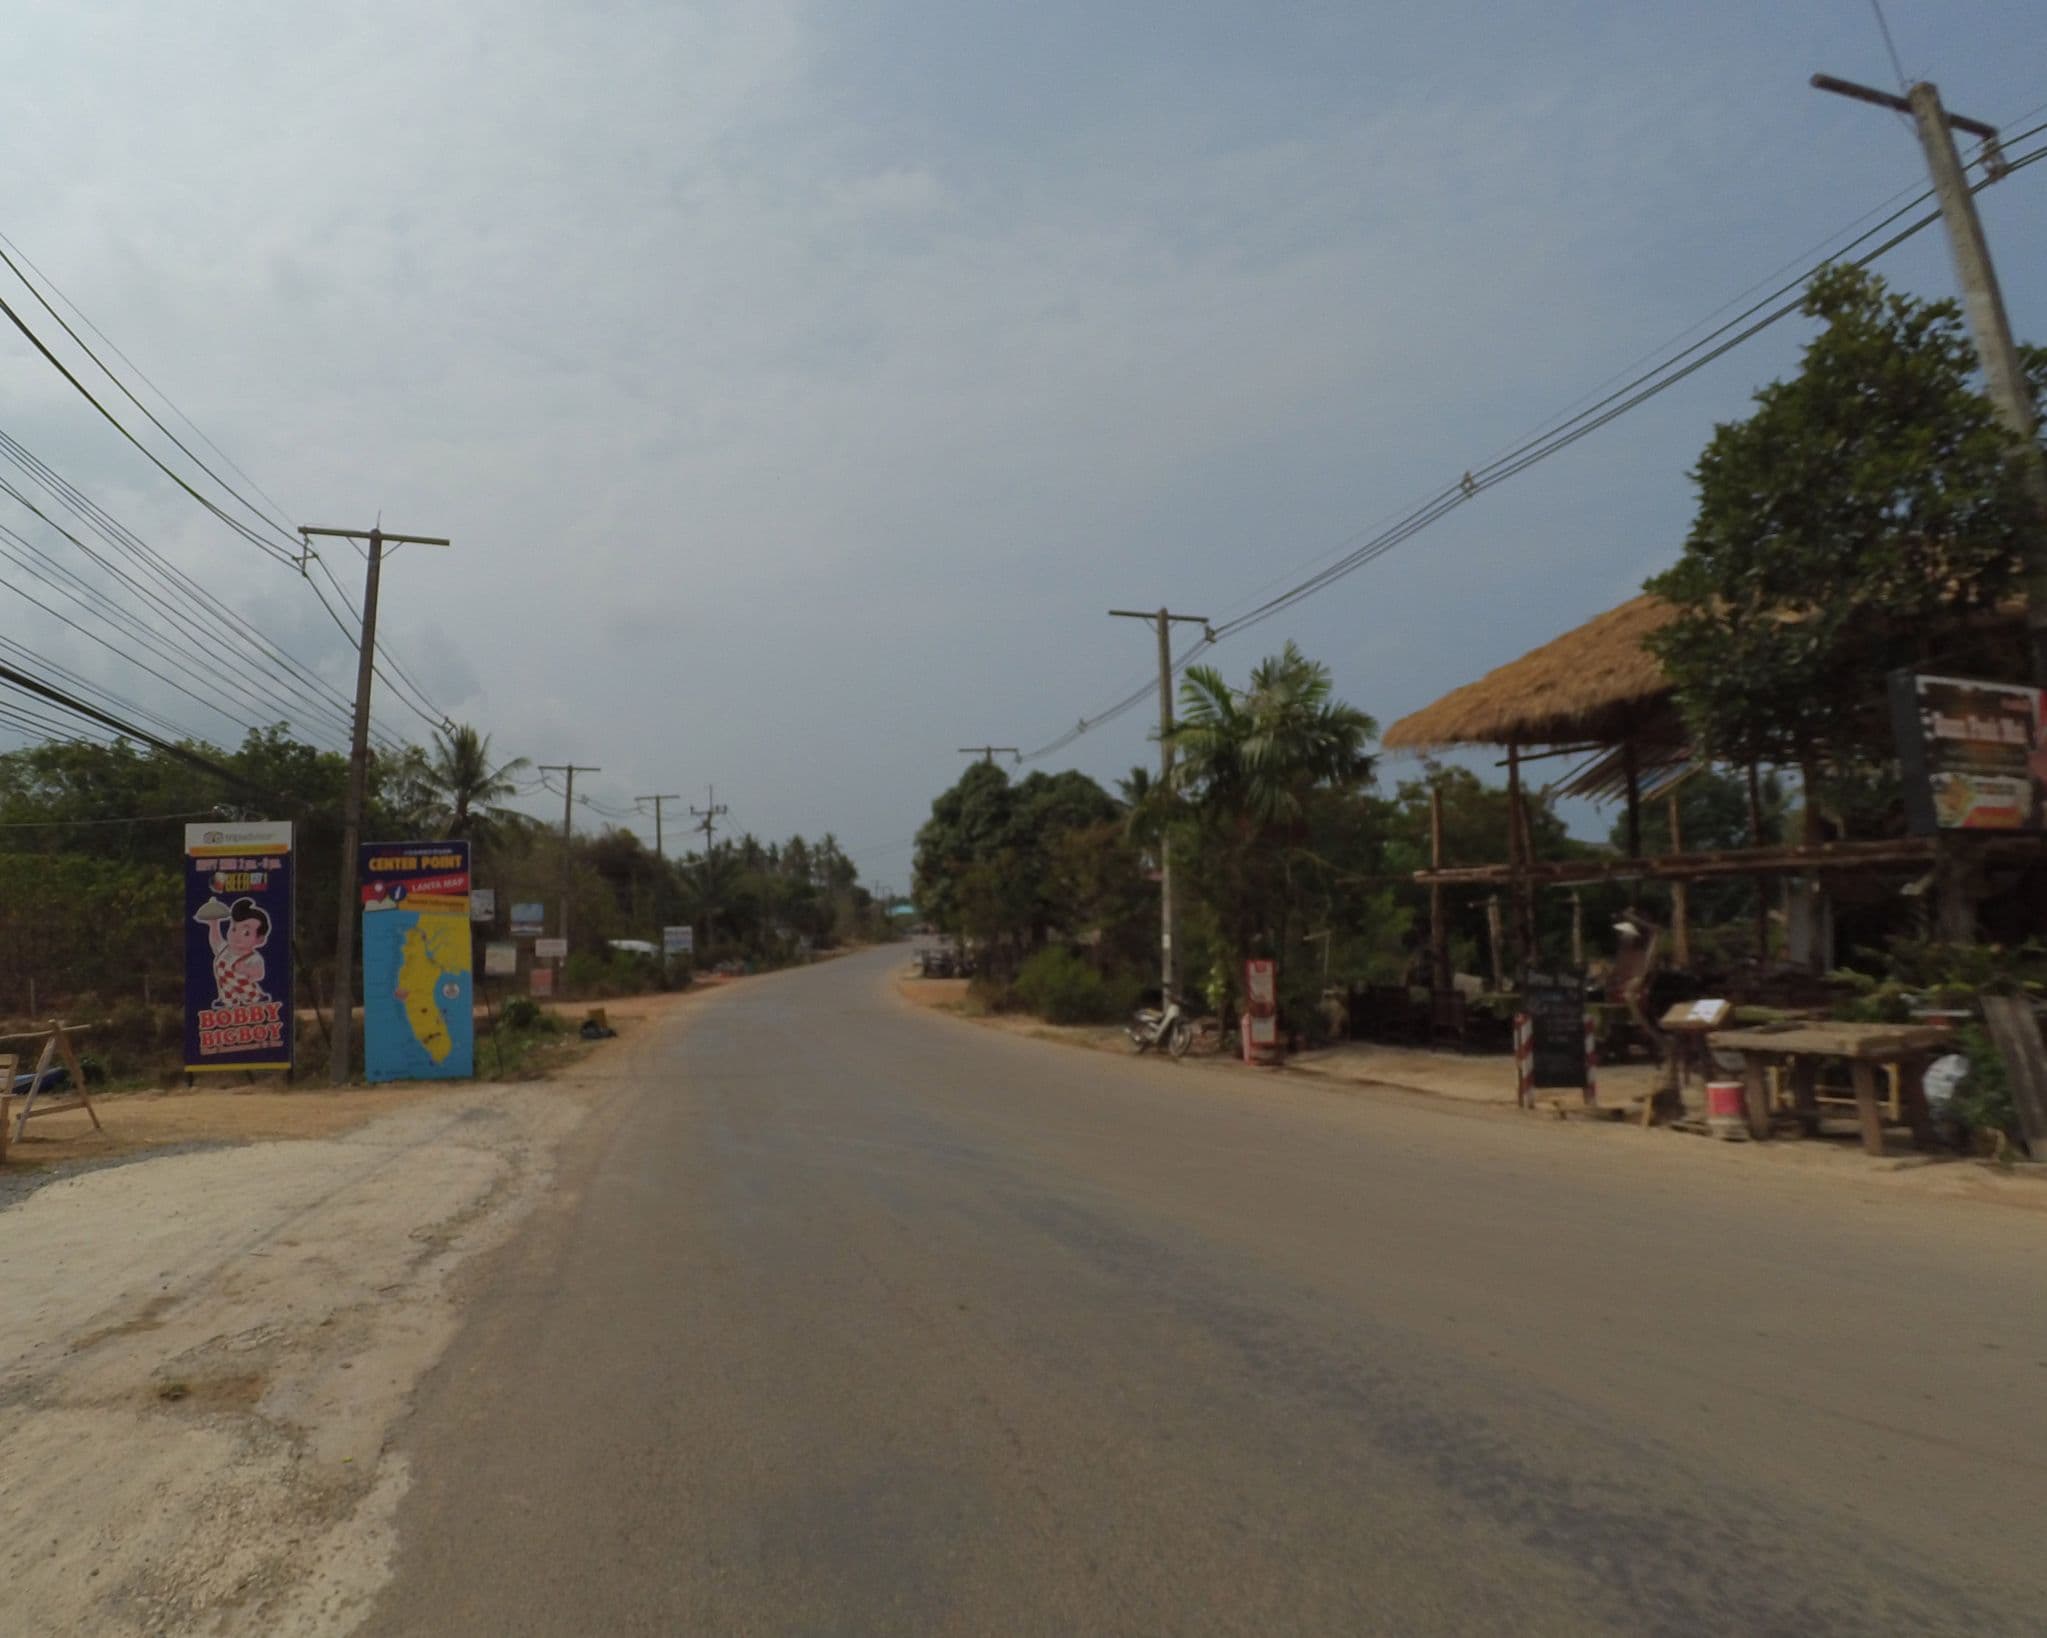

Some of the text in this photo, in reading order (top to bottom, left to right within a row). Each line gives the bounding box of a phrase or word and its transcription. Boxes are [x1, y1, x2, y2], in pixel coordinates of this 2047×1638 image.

[369, 854, 462, 871] CENTER POINT
[198, 1002, 283, 1029] BOBBY
